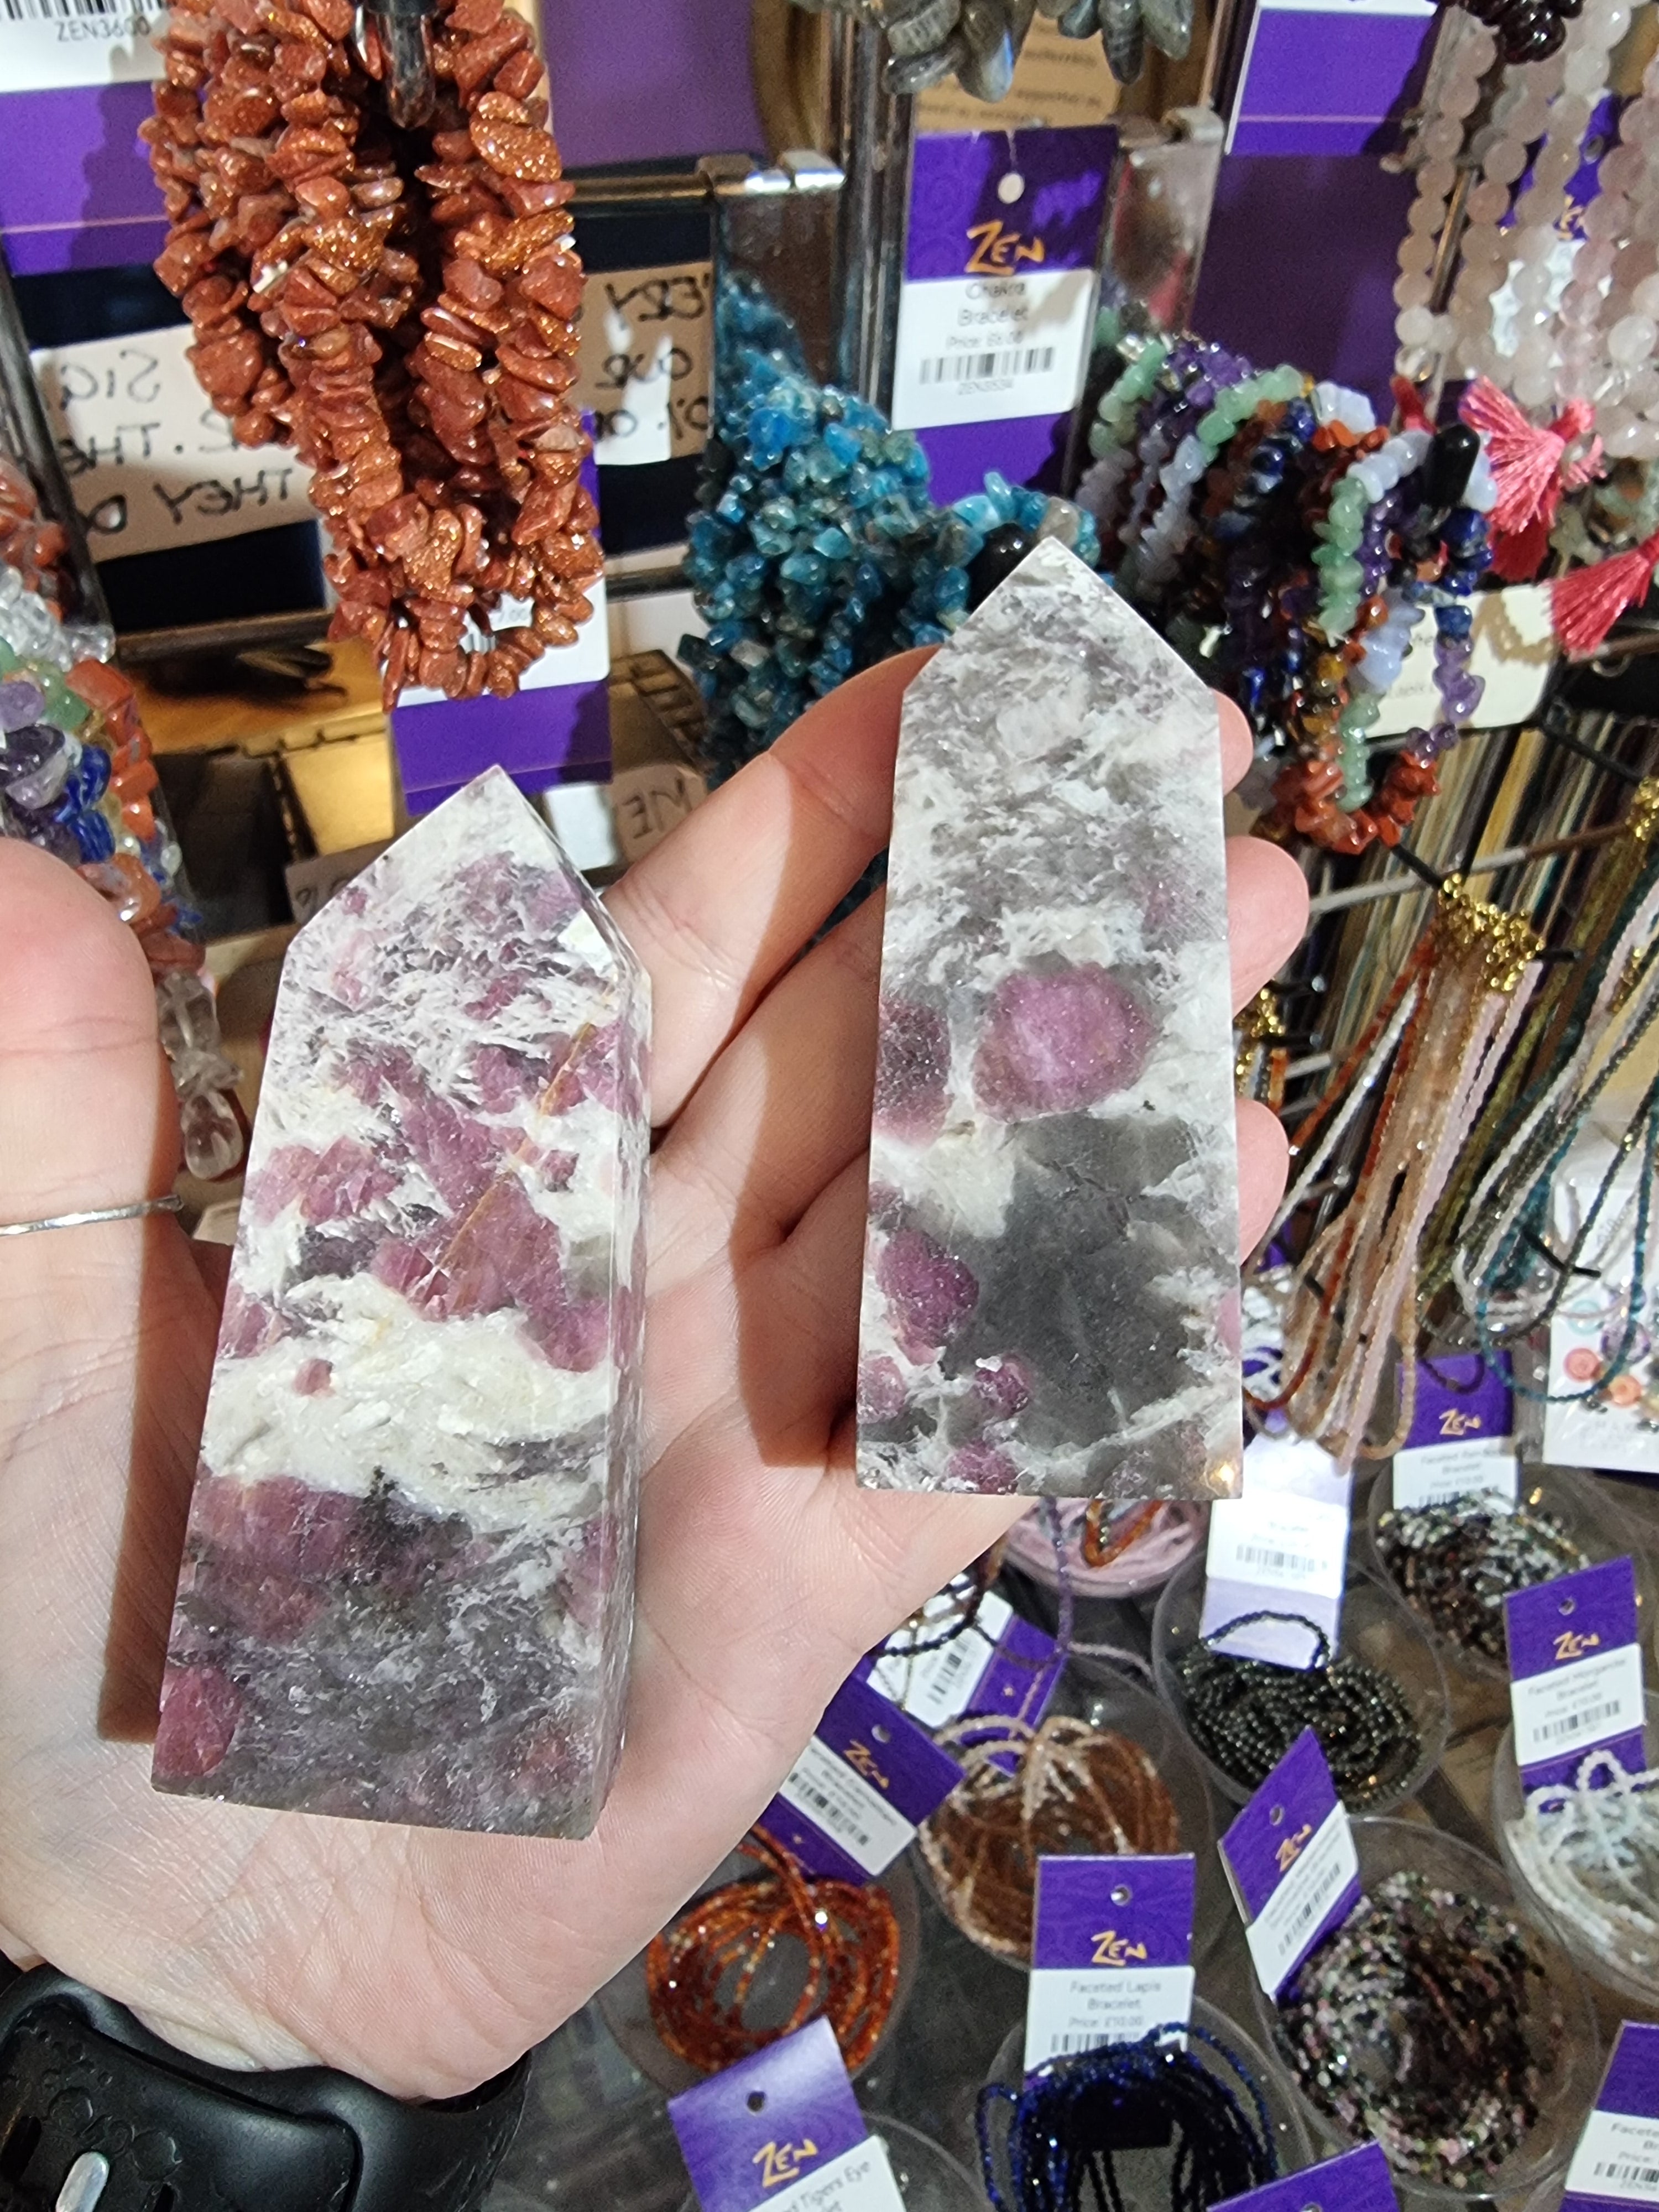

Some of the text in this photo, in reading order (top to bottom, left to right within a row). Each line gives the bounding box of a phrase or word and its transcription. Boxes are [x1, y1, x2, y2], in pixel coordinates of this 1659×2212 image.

[964, 219, 1046, 276] ZEN
[1439, 1408, 1482, 1436] ZEN
[1552, 1631, 1600, 1660] ZEN
[1091, 1930, 1147, 1966] ZEN
[1087, 1997, 1141, 2011] Bracelet
[752, 2138, 818, 2188] ZEN
